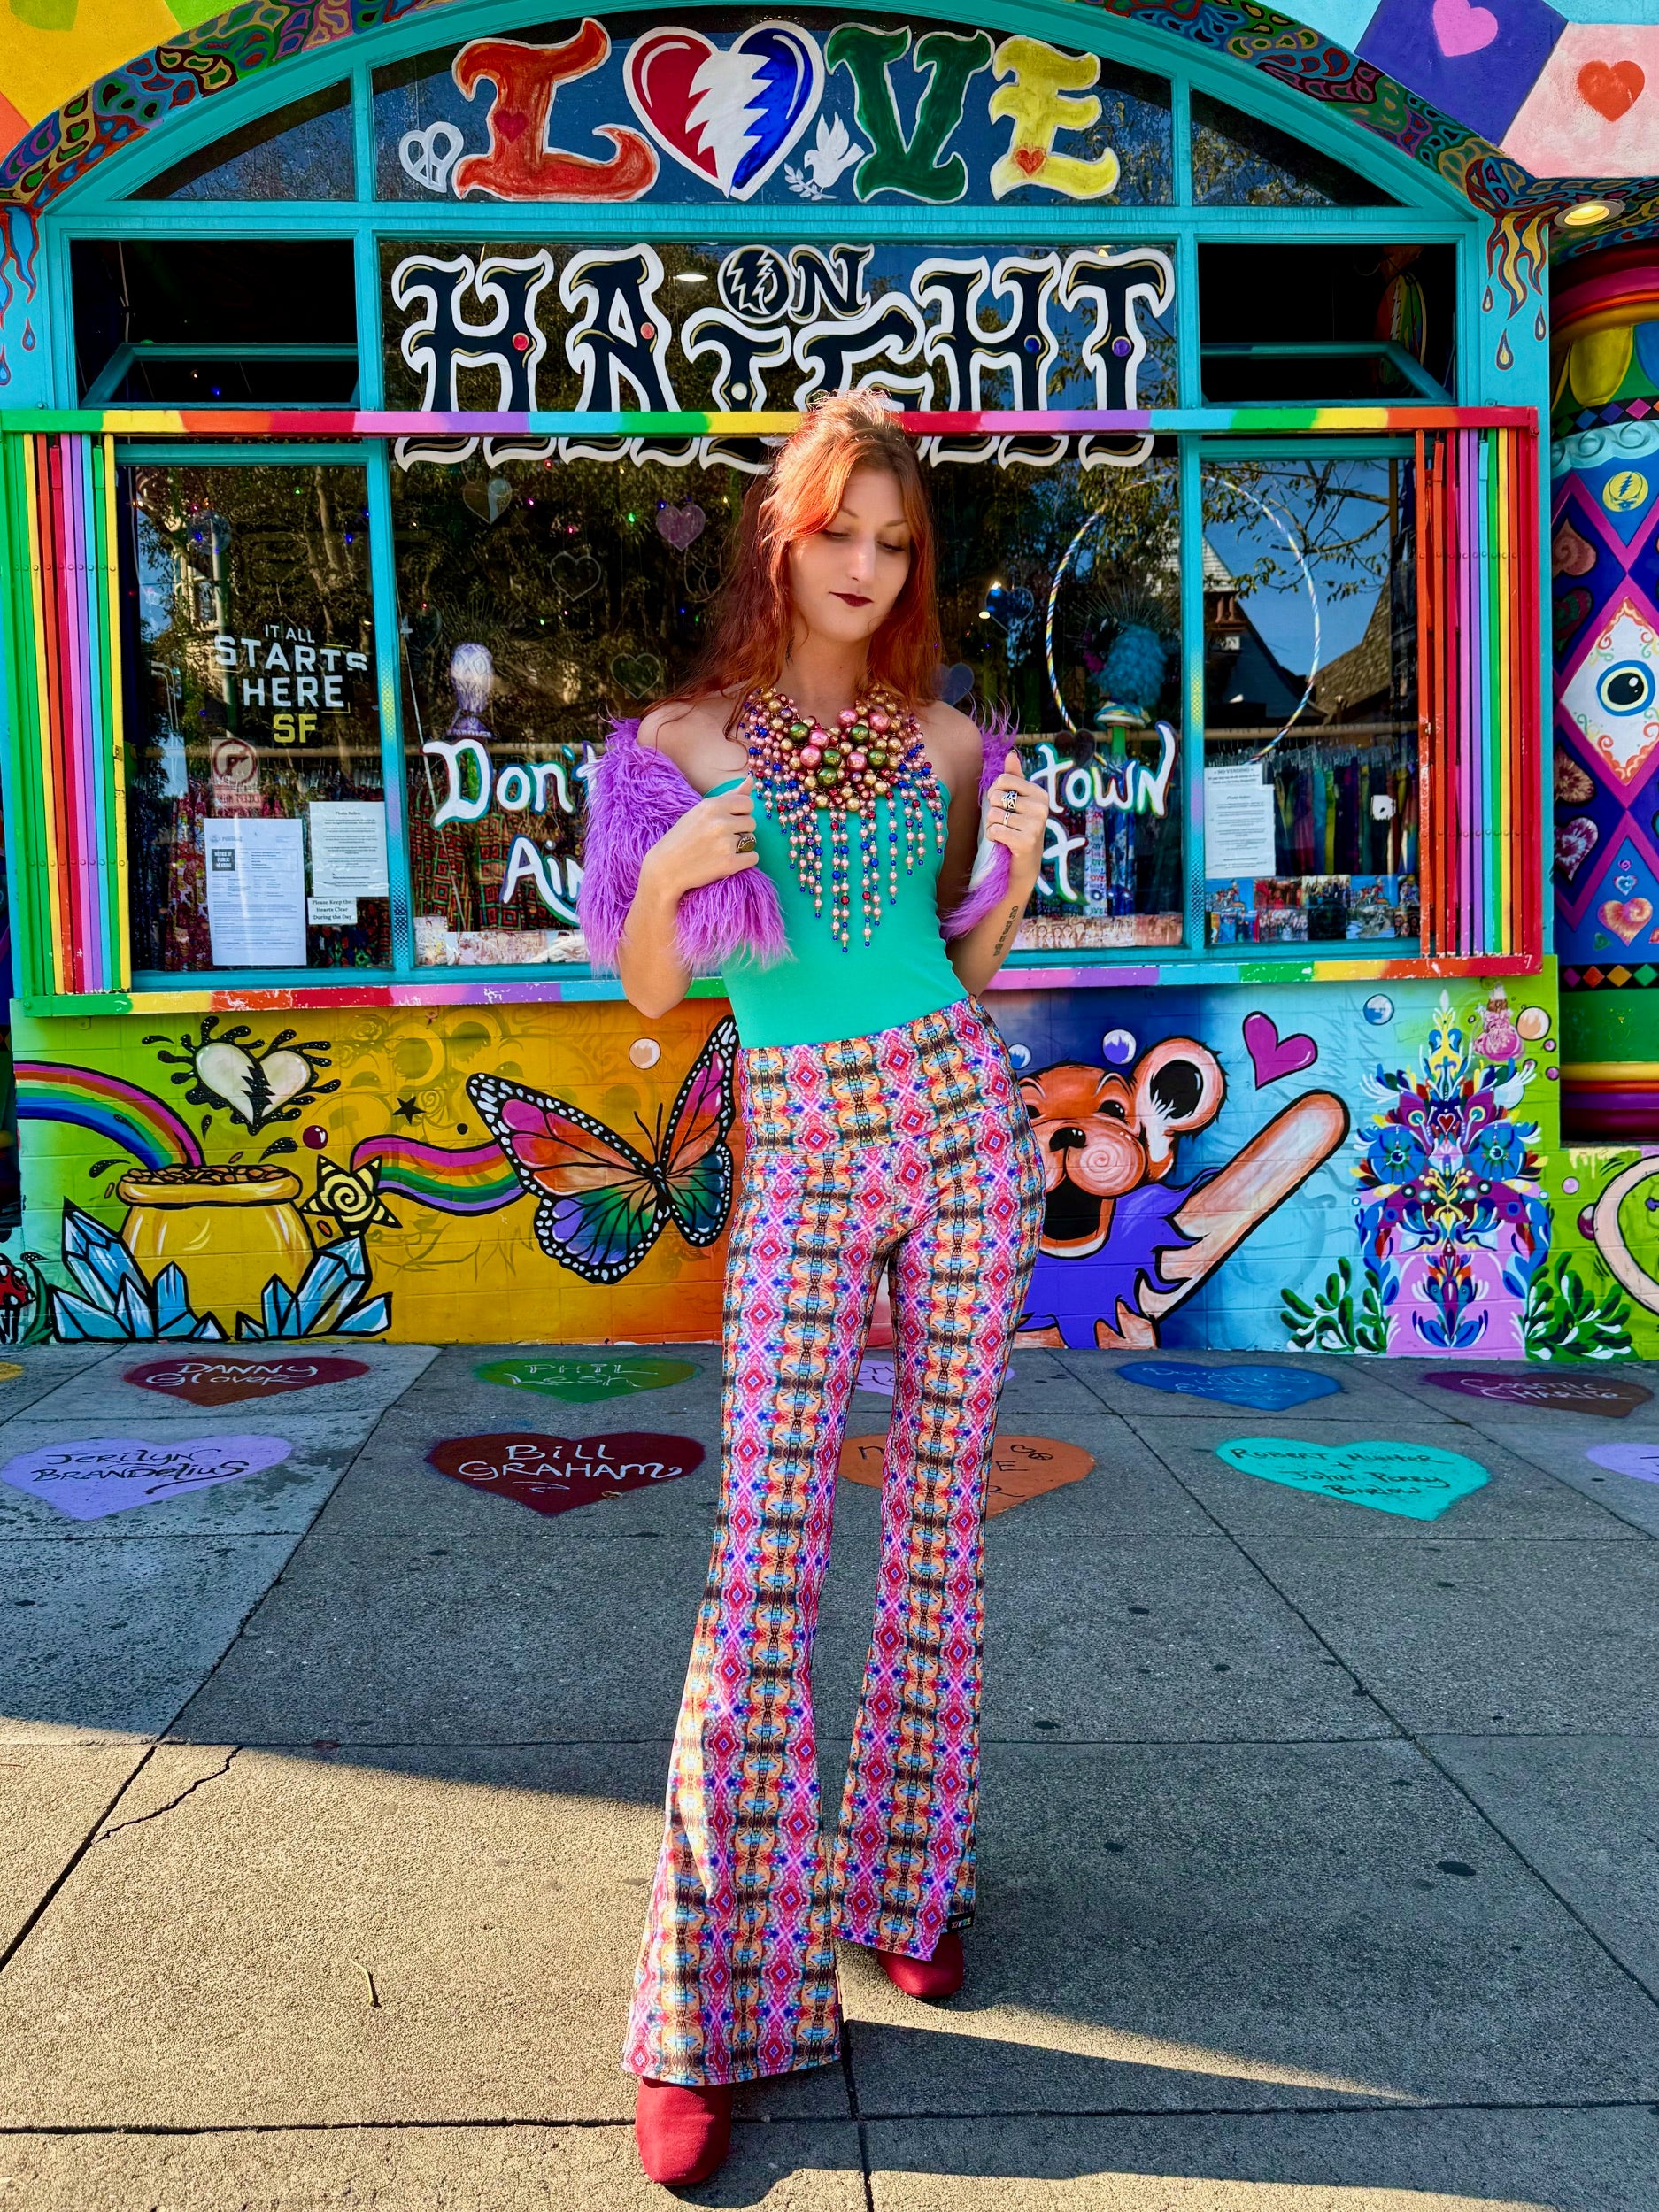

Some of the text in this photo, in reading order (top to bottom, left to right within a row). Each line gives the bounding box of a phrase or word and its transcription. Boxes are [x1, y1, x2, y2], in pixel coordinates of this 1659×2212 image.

[265, 624, 315, 644] IT ALL
[214, 635, 368, 673] STARTS
[243, 675, 344, 707] HERE
[273, 713, 318, 743] SF
